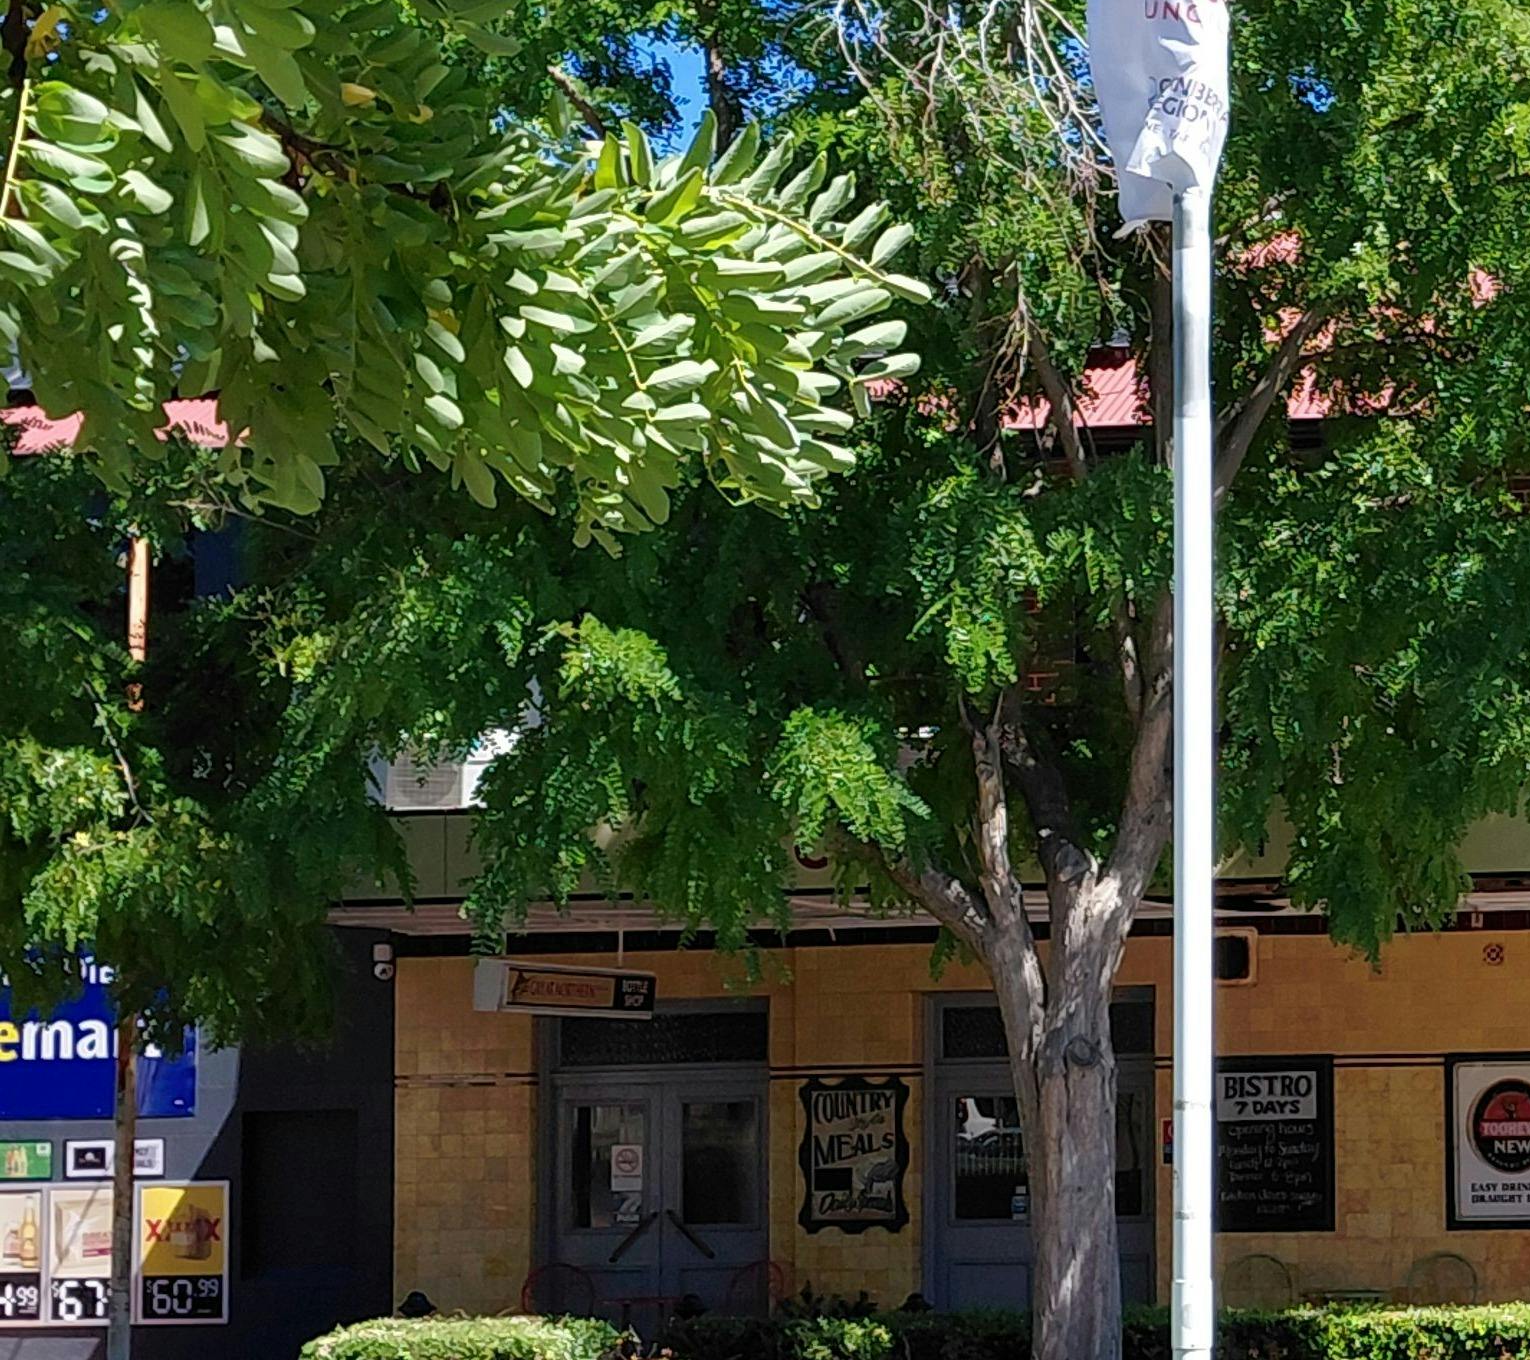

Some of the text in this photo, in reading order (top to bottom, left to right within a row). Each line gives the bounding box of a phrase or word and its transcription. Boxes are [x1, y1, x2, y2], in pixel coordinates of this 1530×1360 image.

[1224, 1075, 1312, 1099] BISTRO
[813, 1091, 894, 1124] COUNTRY
[1234, 1100, 1300, 1115] 7 DAYS
[813, 1132, 895, 1167] MEALS
[1471, 1183, 1498, 1192] EASY
[1471, 1194, 1522, 1203] DRAUGHT
